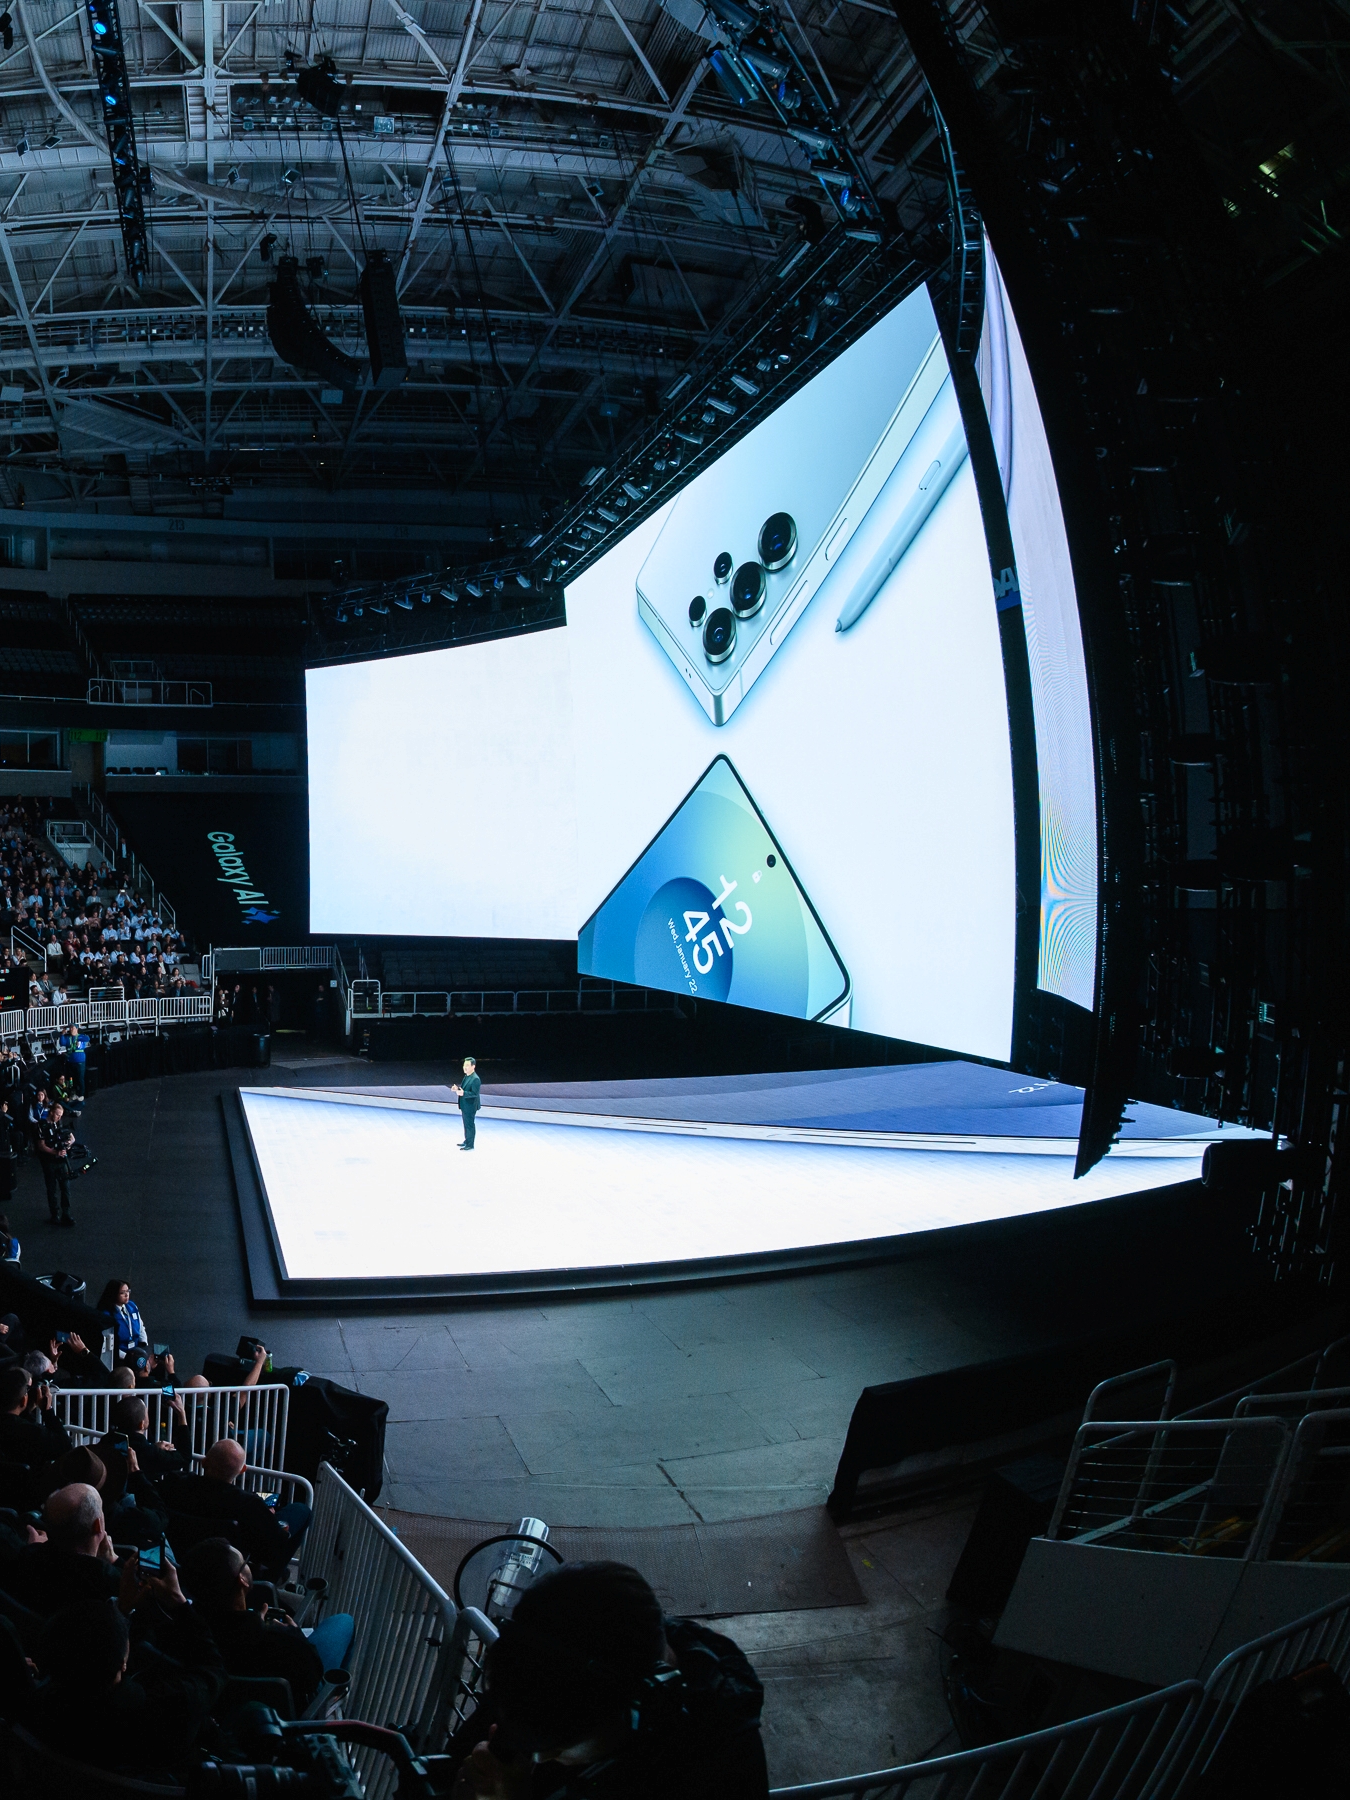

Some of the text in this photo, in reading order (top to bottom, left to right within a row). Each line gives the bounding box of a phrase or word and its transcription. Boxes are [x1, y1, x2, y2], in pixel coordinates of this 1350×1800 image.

[168, 518, 185, 531] 213
[207, 831, 269, 904] Galaxy AI
[682, 911, 724, 974] 45
[711, 874, 753, 949] 12
[667, 918, 698, 994] Wed, January 22
